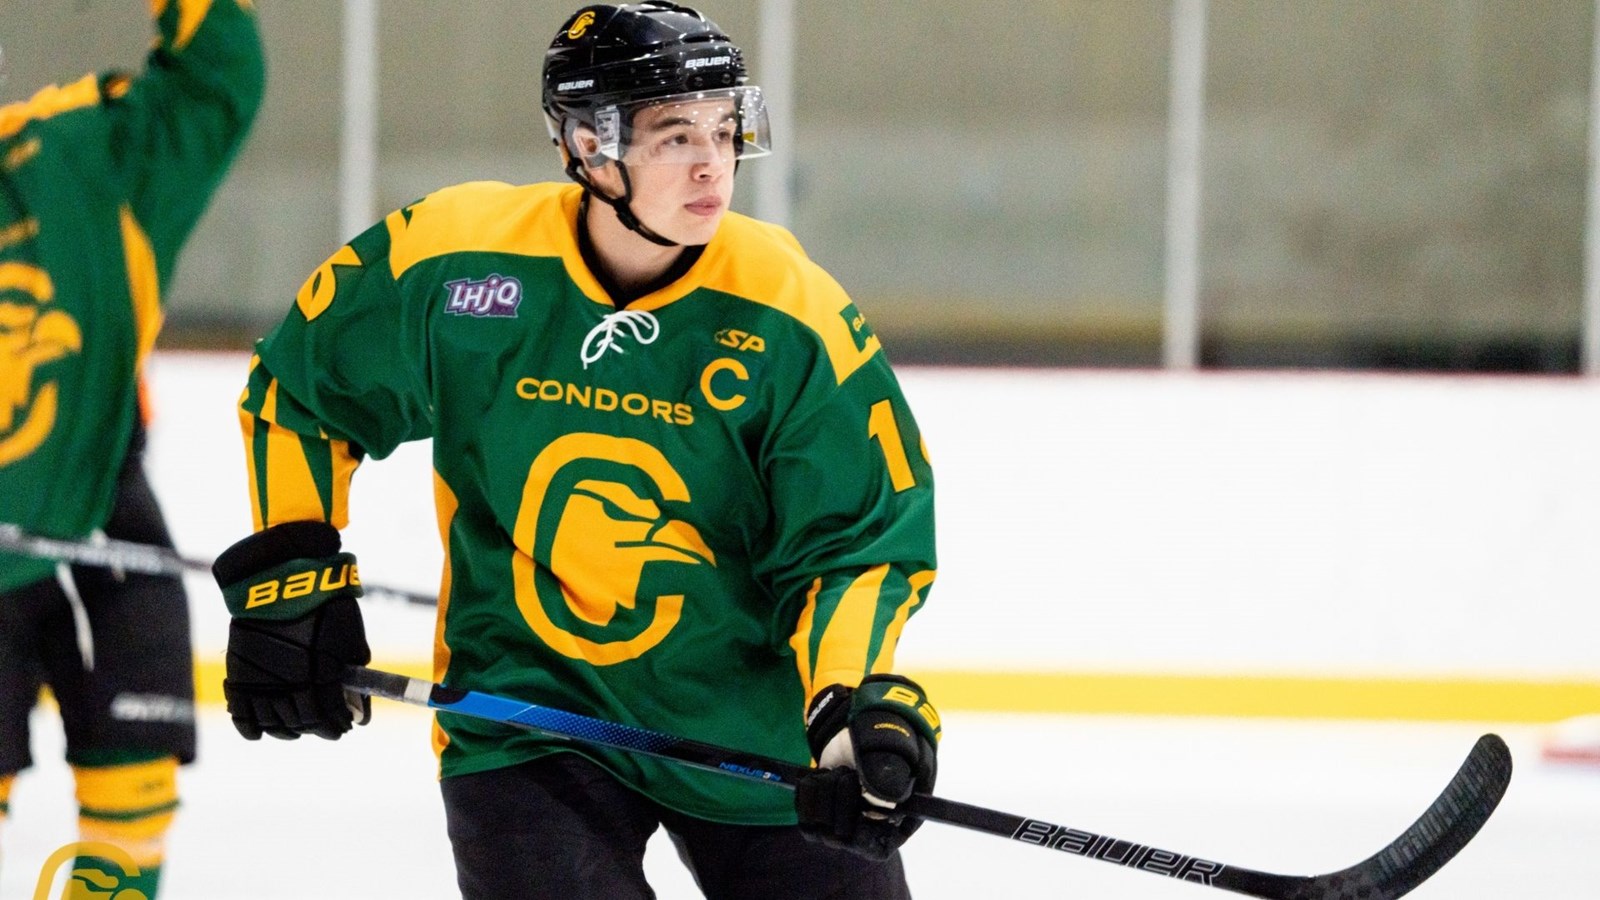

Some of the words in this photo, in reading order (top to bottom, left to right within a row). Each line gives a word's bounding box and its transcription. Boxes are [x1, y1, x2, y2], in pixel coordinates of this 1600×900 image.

[557, 79, 594, 92] BAUER
[685, 56, 731, 69] BAUER
[515, 377, 694, 425] CONDORS
[700, 357, 750, 411] C
[868, 399, 932, 493] 1
[882, 686, 942, 742] BA
[1011, 817, 1224, 887] BAUER
